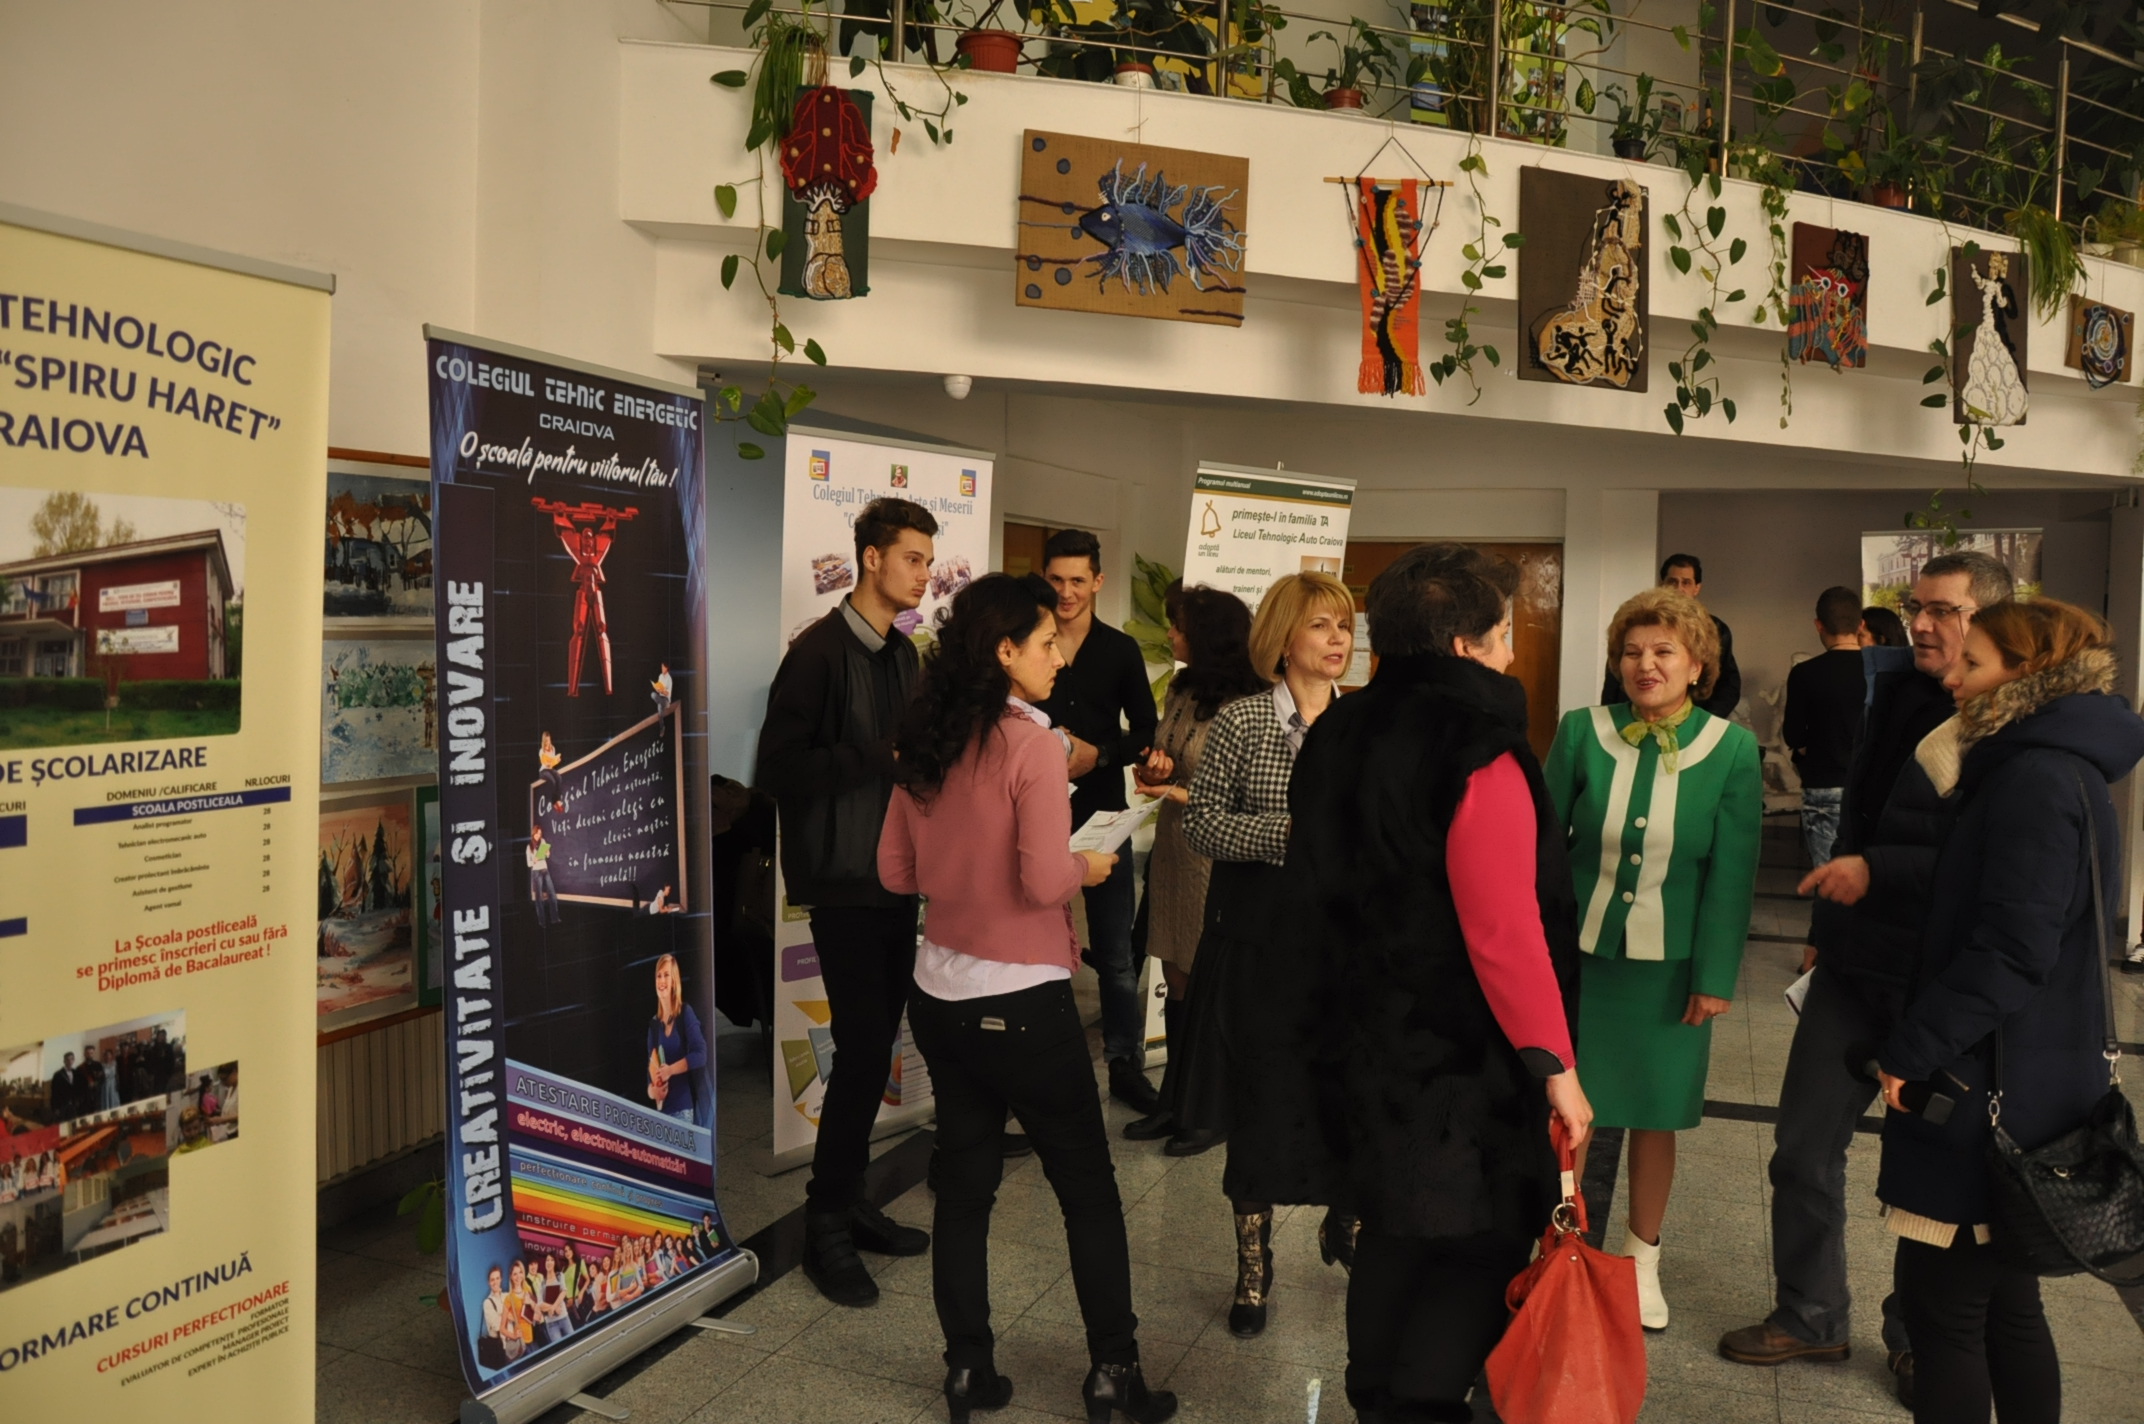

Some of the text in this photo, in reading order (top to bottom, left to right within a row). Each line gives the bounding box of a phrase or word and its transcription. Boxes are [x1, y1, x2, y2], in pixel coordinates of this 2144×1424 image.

[0, 293, 257, 386] TEHNOLOGIC
[539, 413, 615, 440] CRAIOVA
[460, 431, 478, 458] O
[527, 445, 586, 485] pentru
[590, 452, 650, 488] viitorul
[1198, 477, 1226, 488] Programul
[813, 484, 855, 506] Colegiul
[857, 488, 886, 504] Teh
[939, 498, 973, 515] Meserii
[1288, 513, 1317, 526] familia
[1320, 516, 1329, 527] TA
[1233, 529, 1343, 547] Liceul Tehnologic Auto Craiova
[1237, 566, 1244, 575] de
[1233, 585, 1255, 593] traineri
[538, 741, 664, 817] Cogiul Tehnic Energetic
[106, 787, 157, 802] DOMENIU
[262, 807, 272, 816] 28
[576, 811, 606, 830] deveni
[610, 797, 643, 821] colegi
[650, 797, 665, 809] cu
[262, 822, 271, 831] 28
[603, 827, 632, 846] elevii
[262, 838, 271, 847] 28
[262, 853, 271, 862] 28
[262, 869, 271, 878] 28
[262, 884, 271, 893] 28
[115, 939, 132, 954] La
[186, 914, 258, 942] postliceală
[76, 924, 288, 979] se primesc înscrieri cu sau fără
[796, 956, 817, 966] PROFIL
[98, 967, 161, 992] Diplomă
[164, 963, 183, 979] de
[186, 947, 264, 973] Bacalaureat
[516, 1076, 696, 1152] ATESTARE PROFESIONALĂ
[517, 1110, 569, 1140] electric,
[522, 1213, 577, 1232] instruire
[125, 1251, 252, 1320] CONTINUĂ
[250, 1297, 290, 1321] FORMATOR
[96, 1280, 290, 1374] CURSURI PERFECȚIONARE
[222, 1316, 290, 1352] MANAGER PROIECT
[120, 1359, 170, 1387] EVALUATOR
[171, 1354, 182, 1366] DE
[237, 1306, 290, 1336] PROFESIONALE
[188, 1358, 217, 1377] EXPERT
[261, 1325, 290, 1344] PUBLICE
